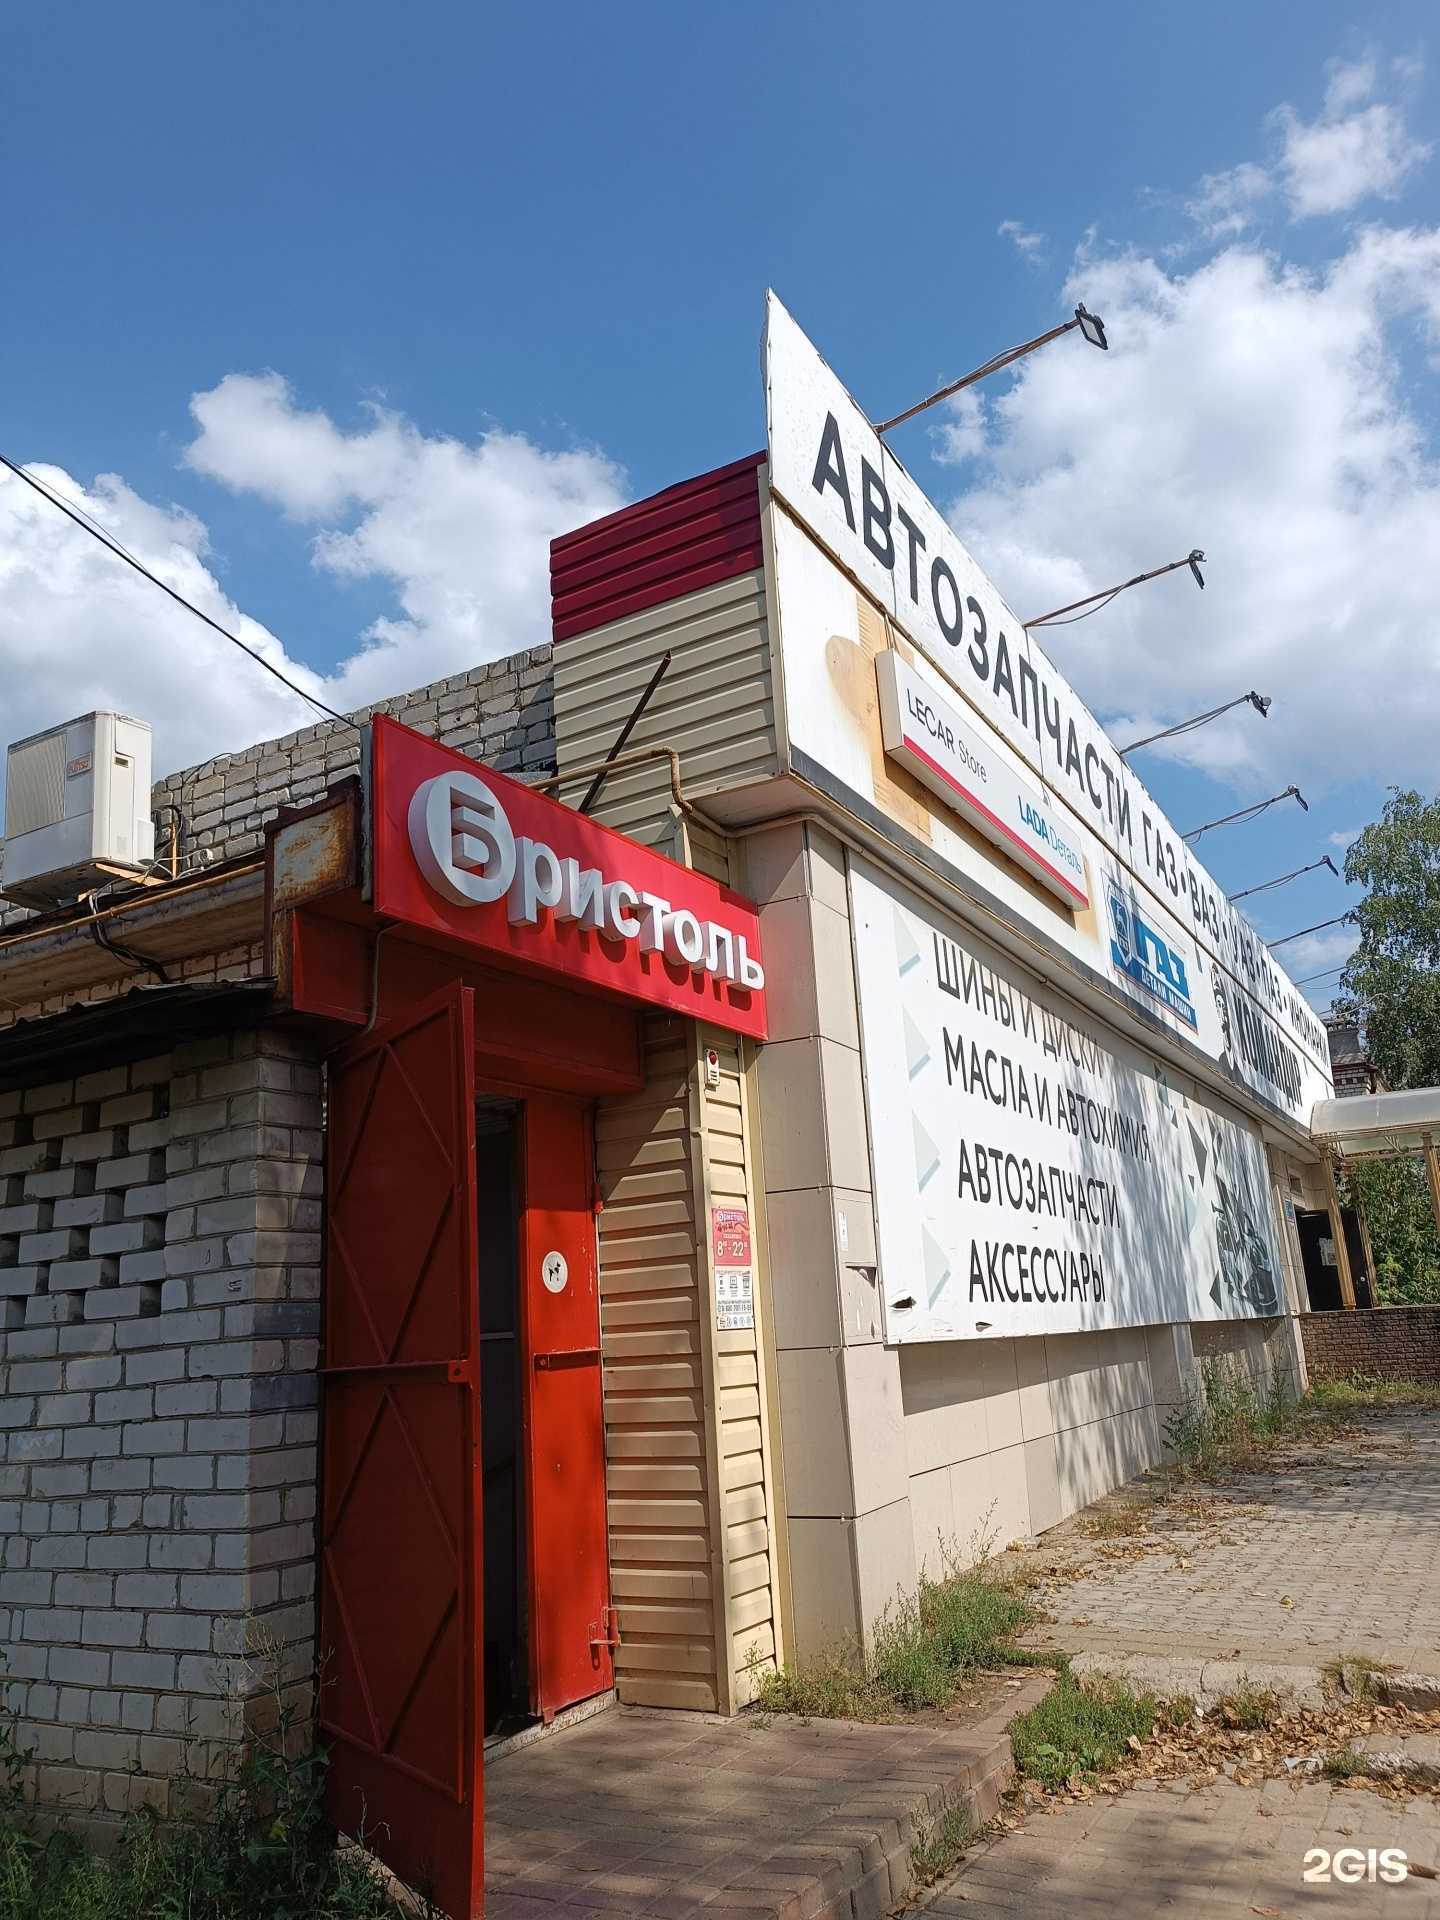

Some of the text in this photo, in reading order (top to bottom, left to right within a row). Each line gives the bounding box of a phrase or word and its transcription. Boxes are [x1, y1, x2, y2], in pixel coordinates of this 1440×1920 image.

[812, 410, 1133, 847] АВТОЗАПЧАСТИ
[1142, 810, 1178, 897] ГАЗ
[1188, 868, 1219, 943] ВАЗ
[906, 687, 988, 784] LECAR Store
[1018, 795, 1050, 847] LADA
[408, 770, 766, 991] Бристоль
[1131, 911, 1190, 1001] ГАЗ
[933, 932, 1103, 1079] ШИНЫ И ДИСКИ
[942, 1026, 1152, 1164] МАСЛА И АВТОХИМИЯ
[957, 1138, 1121, 1229] АВТОЗАПЧАСТИ
[968, 1239, 1106, 1304] АКСЕССУАРЫ
